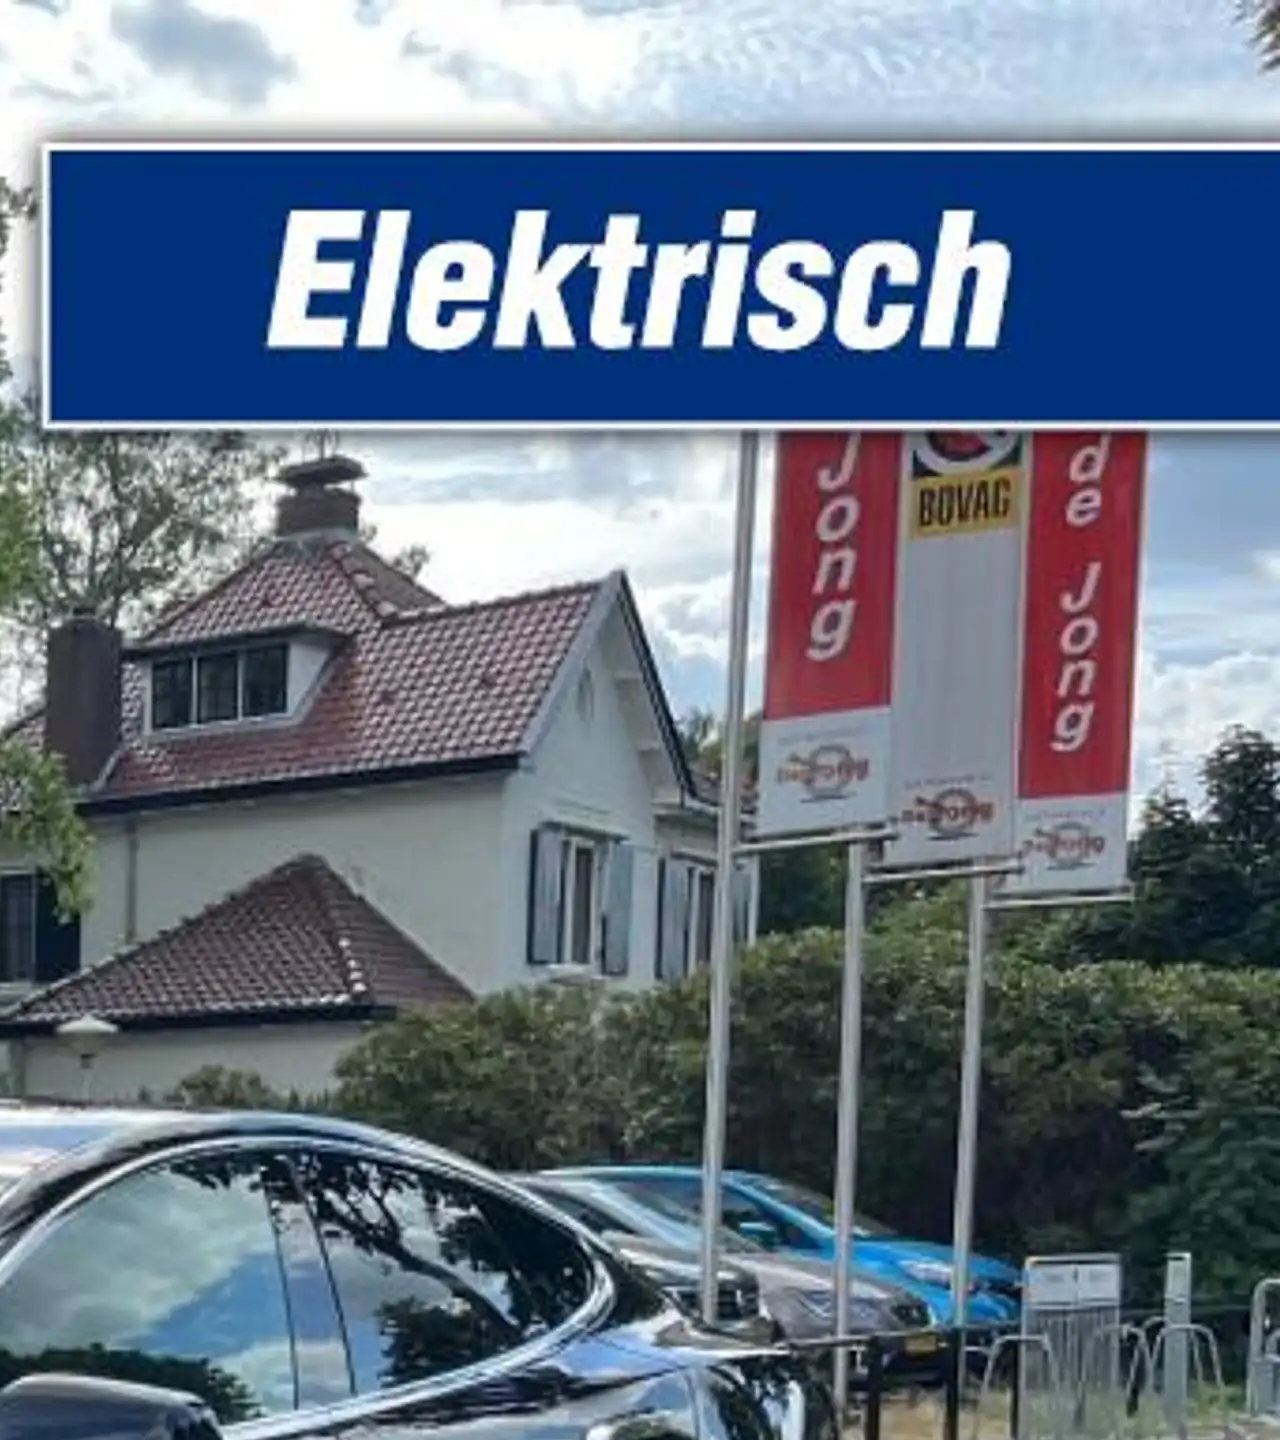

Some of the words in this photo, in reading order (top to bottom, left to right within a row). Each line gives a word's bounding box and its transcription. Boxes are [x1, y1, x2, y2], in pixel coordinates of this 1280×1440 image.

[805, 432, 862, 660] Jong
[918, 477, 1011, 527] BOVAG
[1050, 562, 1102, 752] Jong
